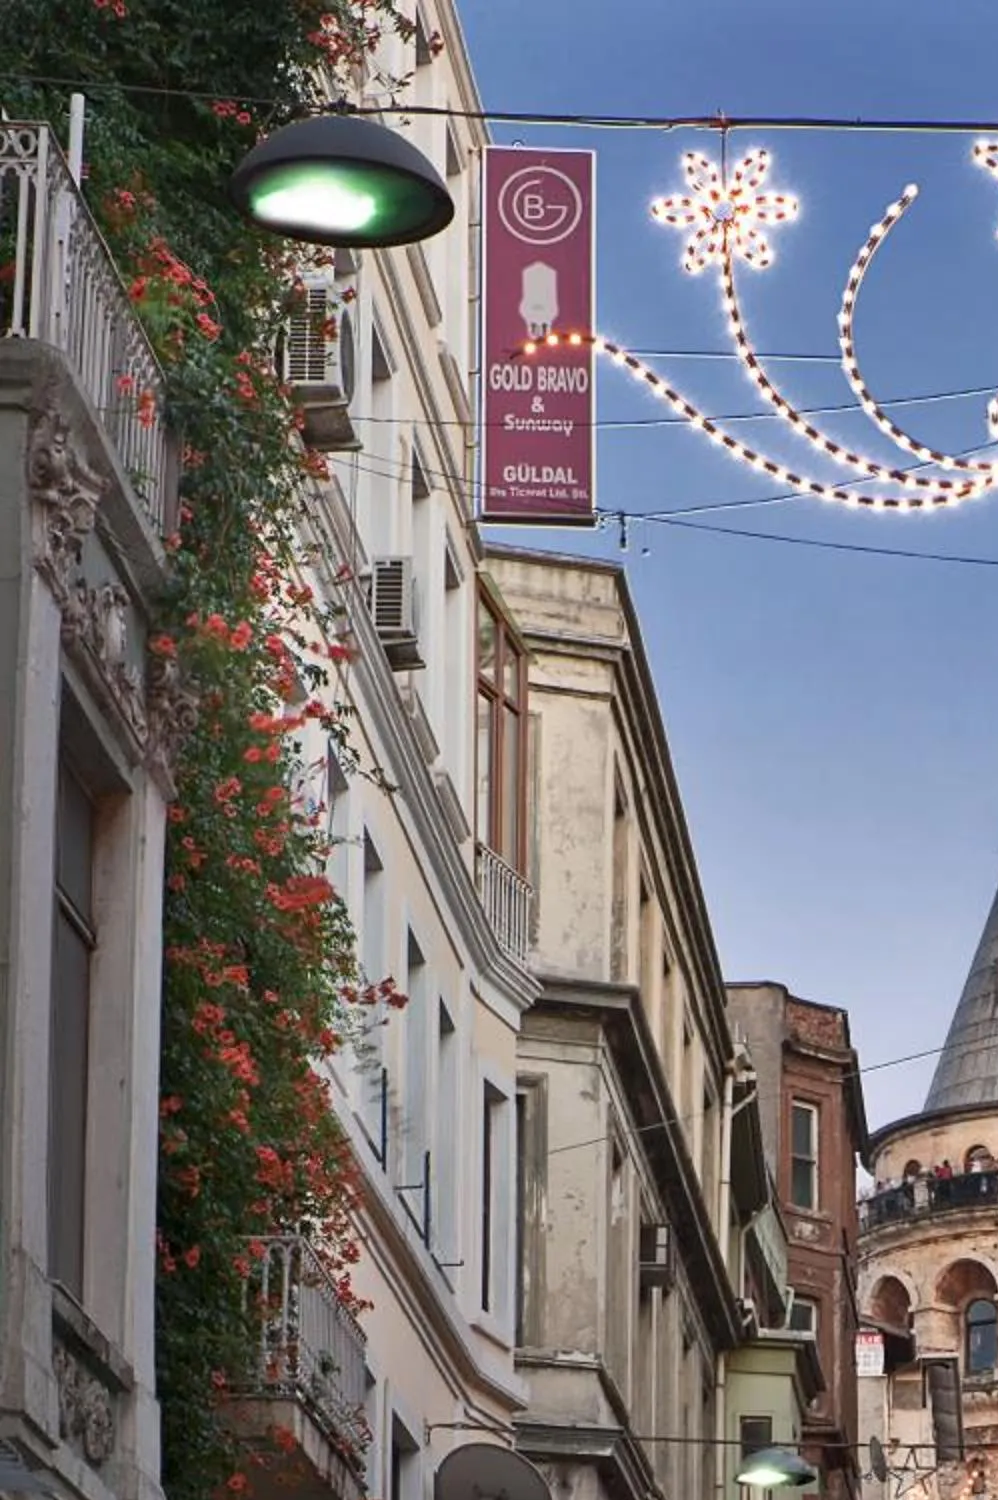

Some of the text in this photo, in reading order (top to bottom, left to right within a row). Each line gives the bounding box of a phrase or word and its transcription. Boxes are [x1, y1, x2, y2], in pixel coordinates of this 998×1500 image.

[489, 363, 588, 394] GOLD BRAVO
[530, 395, 545, 413] &
[503, 413, 574, 437] Sunway
[503, 463, 578, 485] GÜLDAL
